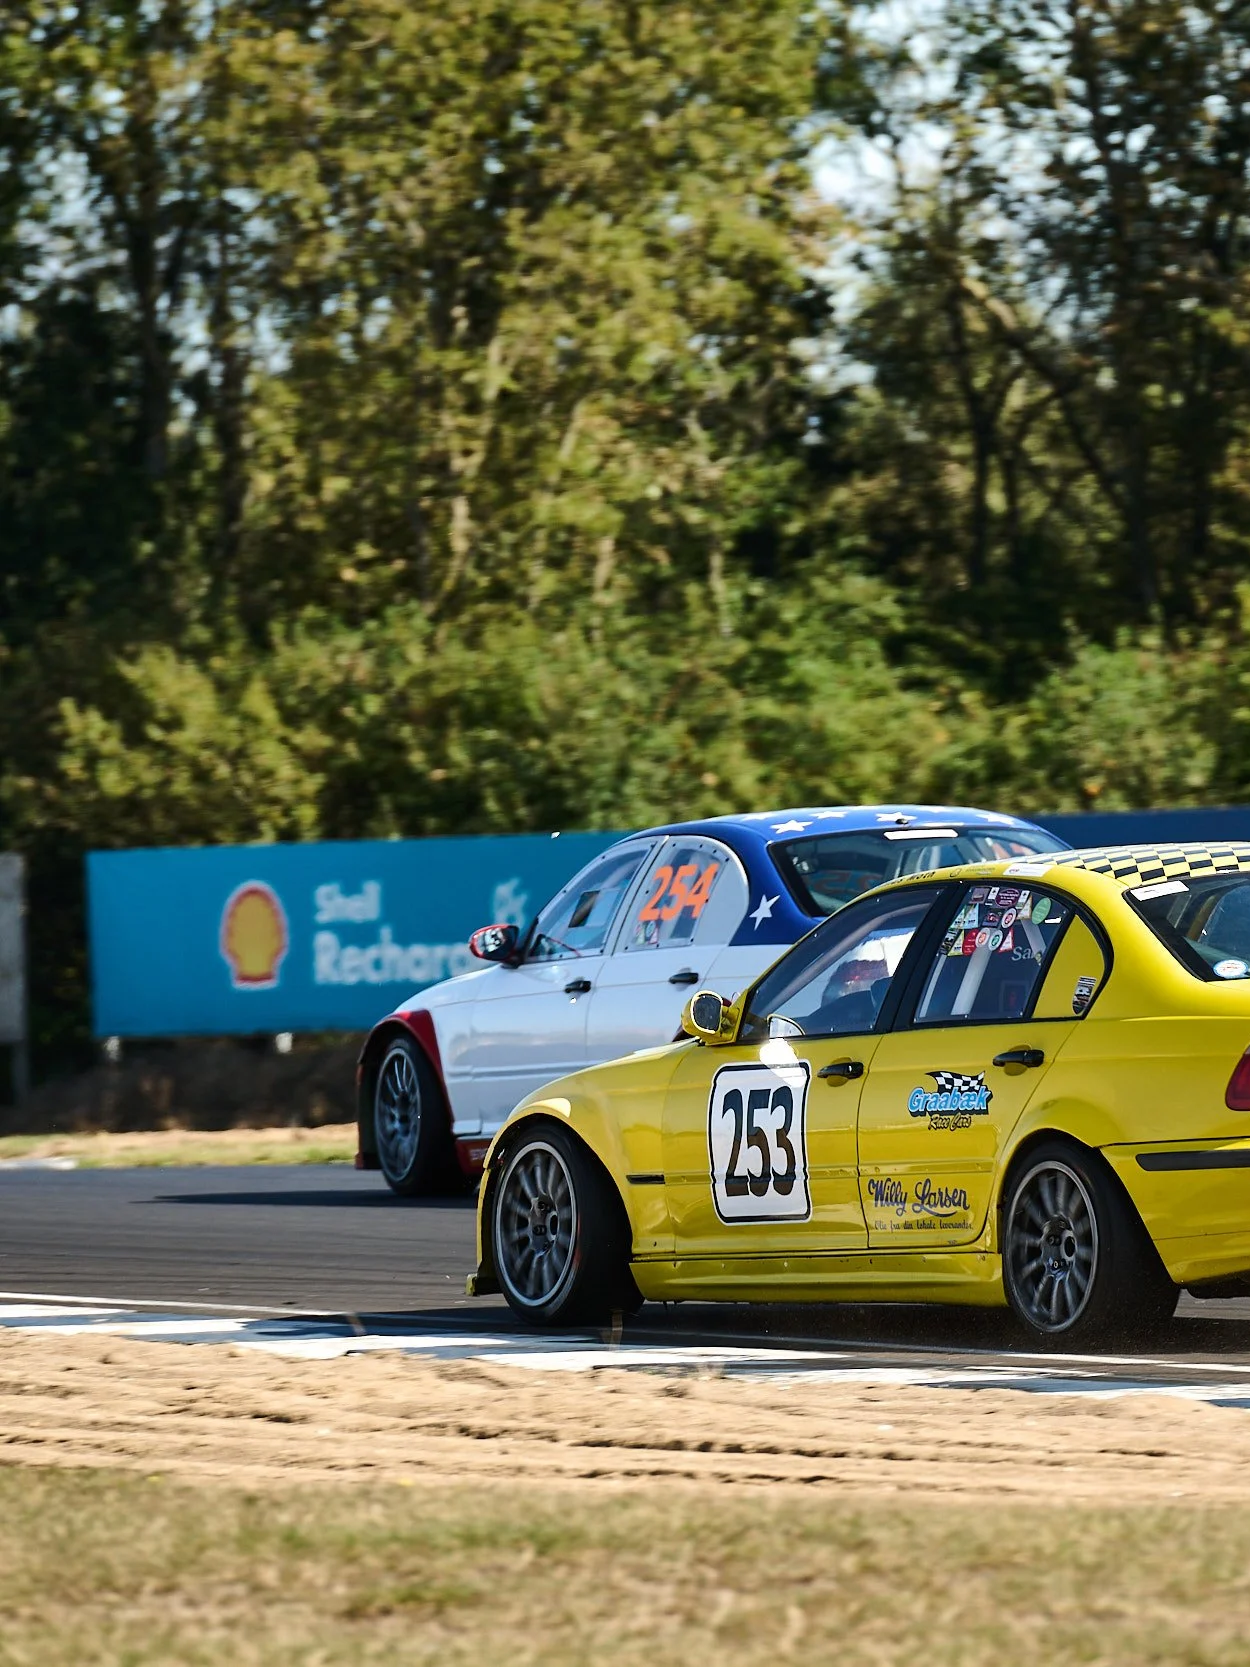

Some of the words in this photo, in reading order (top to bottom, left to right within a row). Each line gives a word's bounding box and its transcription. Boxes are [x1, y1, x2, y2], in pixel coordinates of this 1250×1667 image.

[314, 881, 381, 923] Shell
[638, 863, 720, 921] 254
[722, 1085, 796, 1197] 253
[868, 1177, 908, 1216] Willy
[912, 1178, 970, 1217] Larsen
